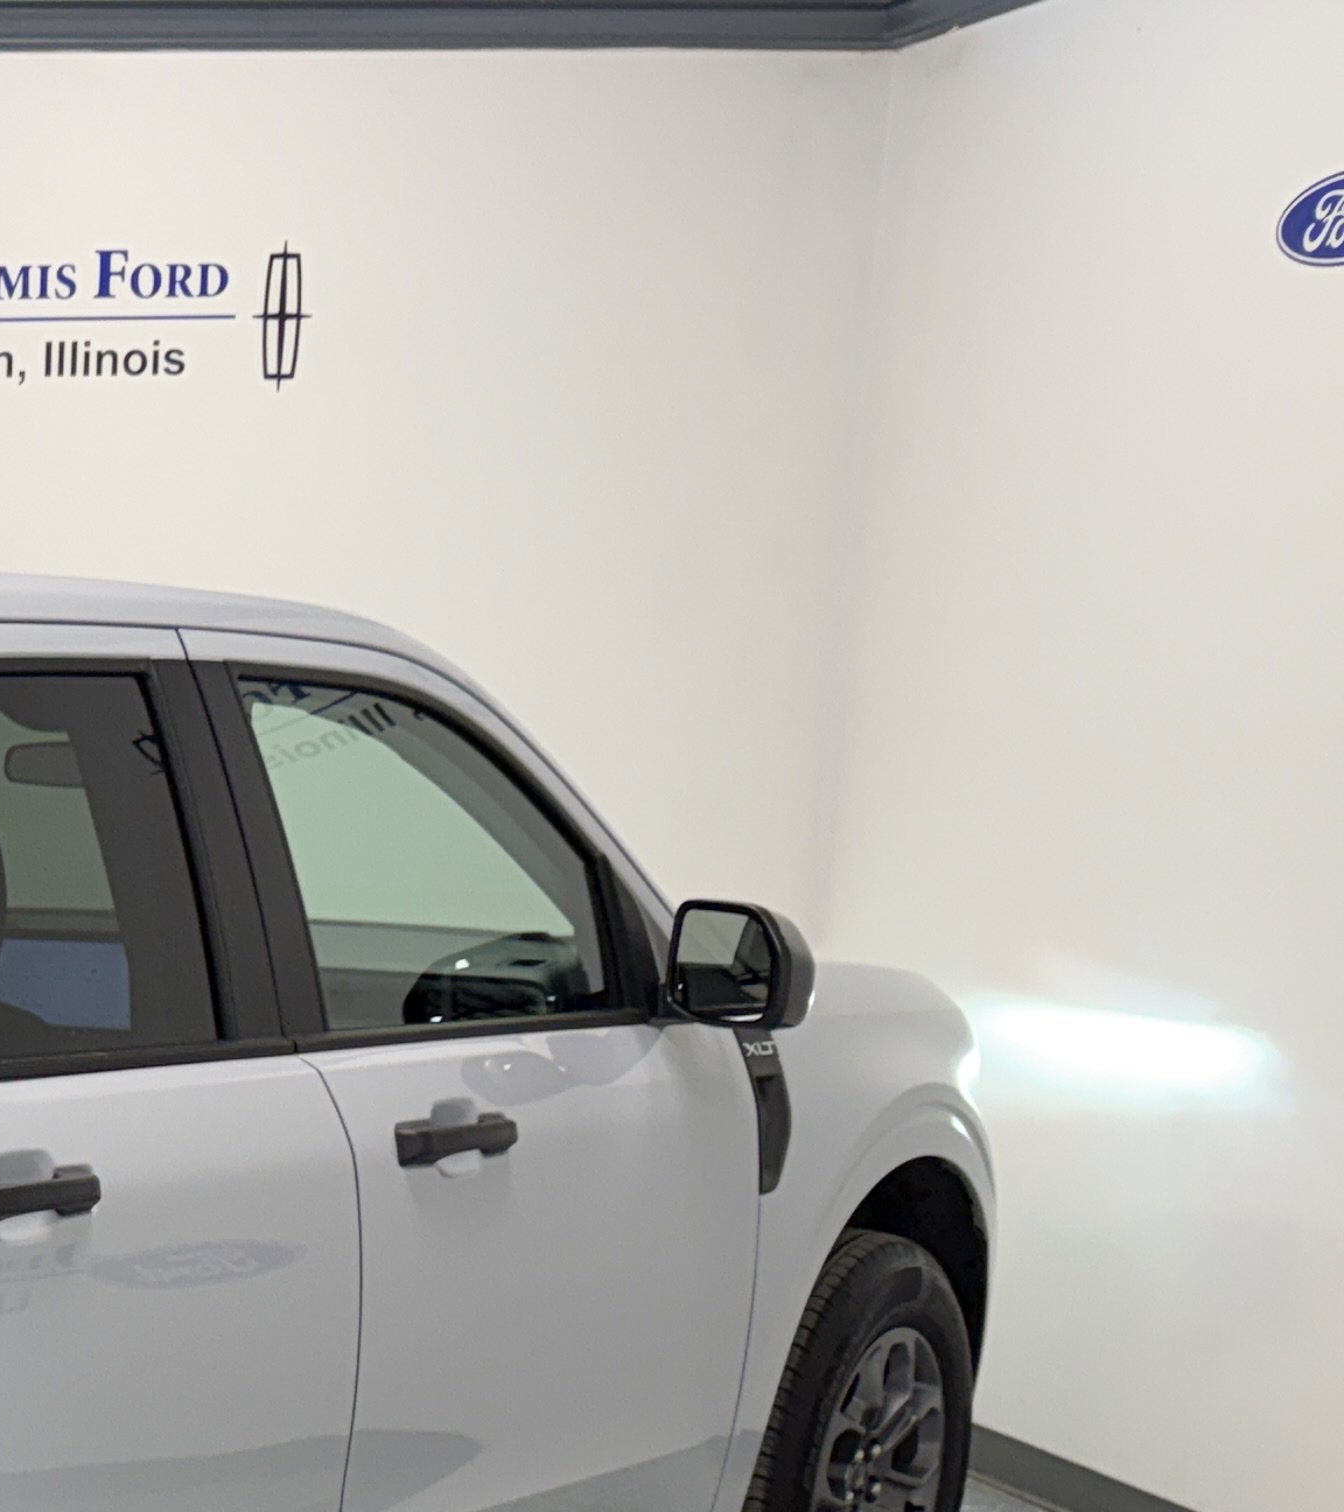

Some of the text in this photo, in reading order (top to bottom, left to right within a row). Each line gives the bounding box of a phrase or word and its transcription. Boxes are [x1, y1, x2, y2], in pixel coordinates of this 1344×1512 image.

[93, 249, 230, 299] FORD
[44, 339, 186, 378] Illinois
[742, 1040, 776, 1057] XLT
